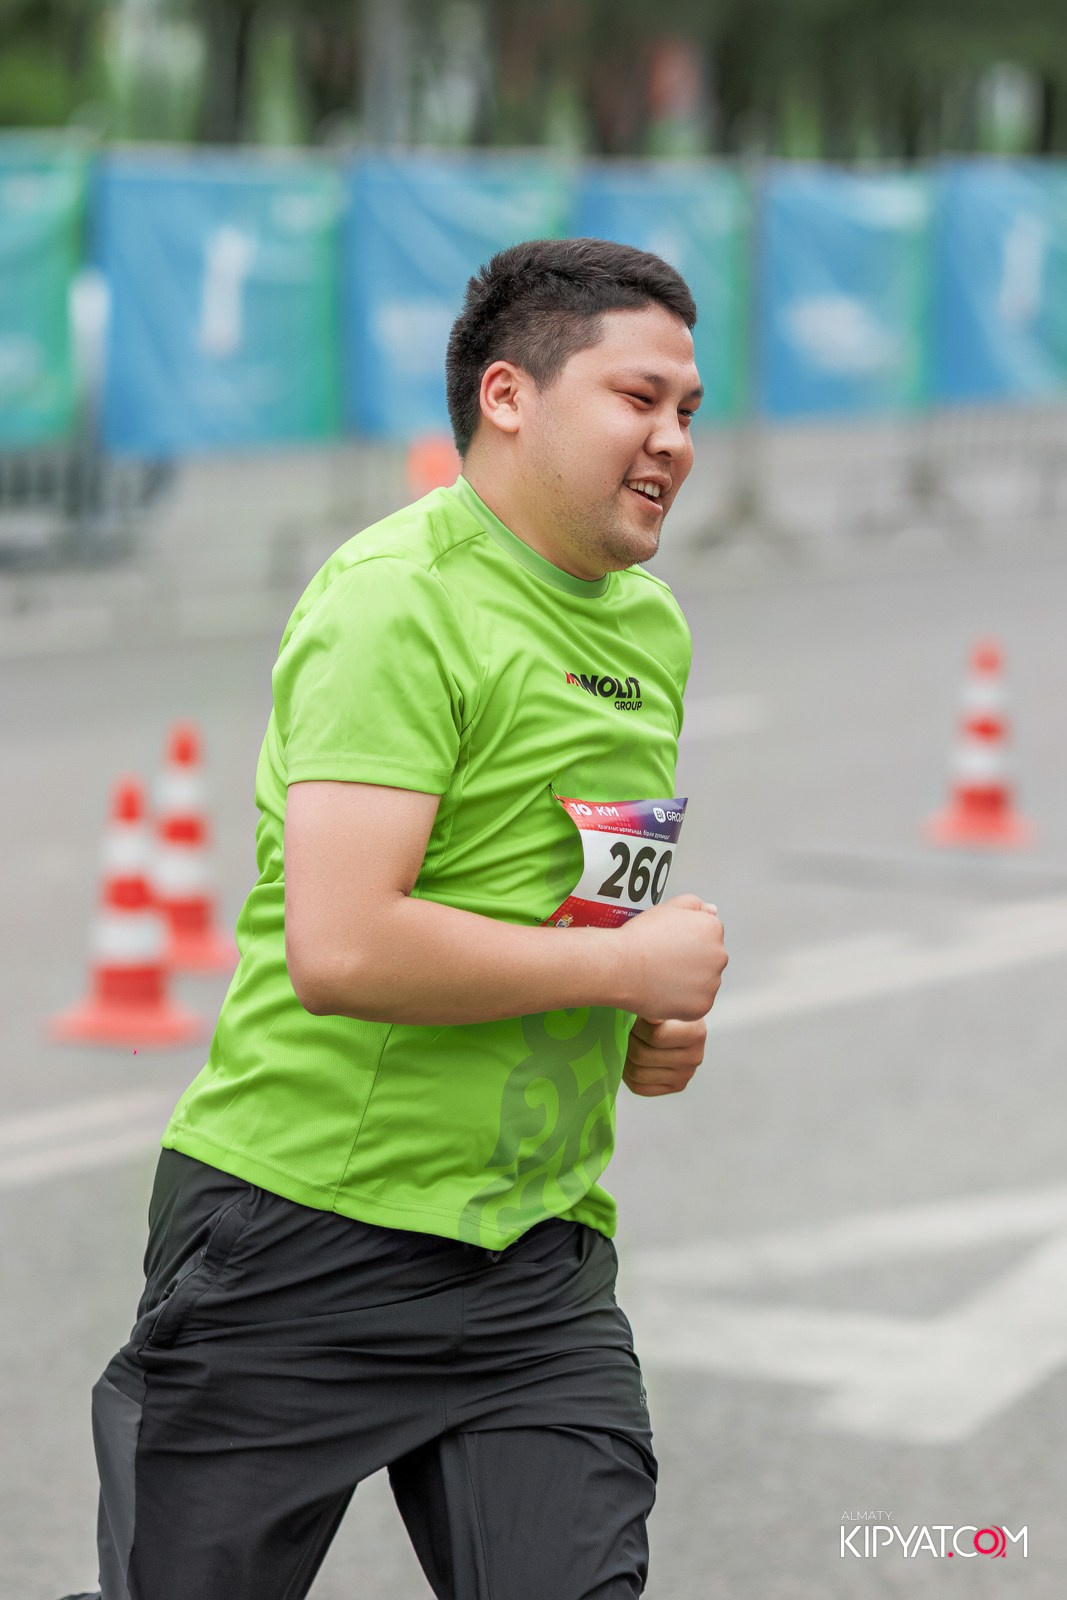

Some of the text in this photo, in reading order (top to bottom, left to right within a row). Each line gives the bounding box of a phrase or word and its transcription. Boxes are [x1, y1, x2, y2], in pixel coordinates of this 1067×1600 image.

[614, 701, 642, 711] GROUP
[569, 803, 620, 817] 10 KM
[597, 842, 673, 906] 260
